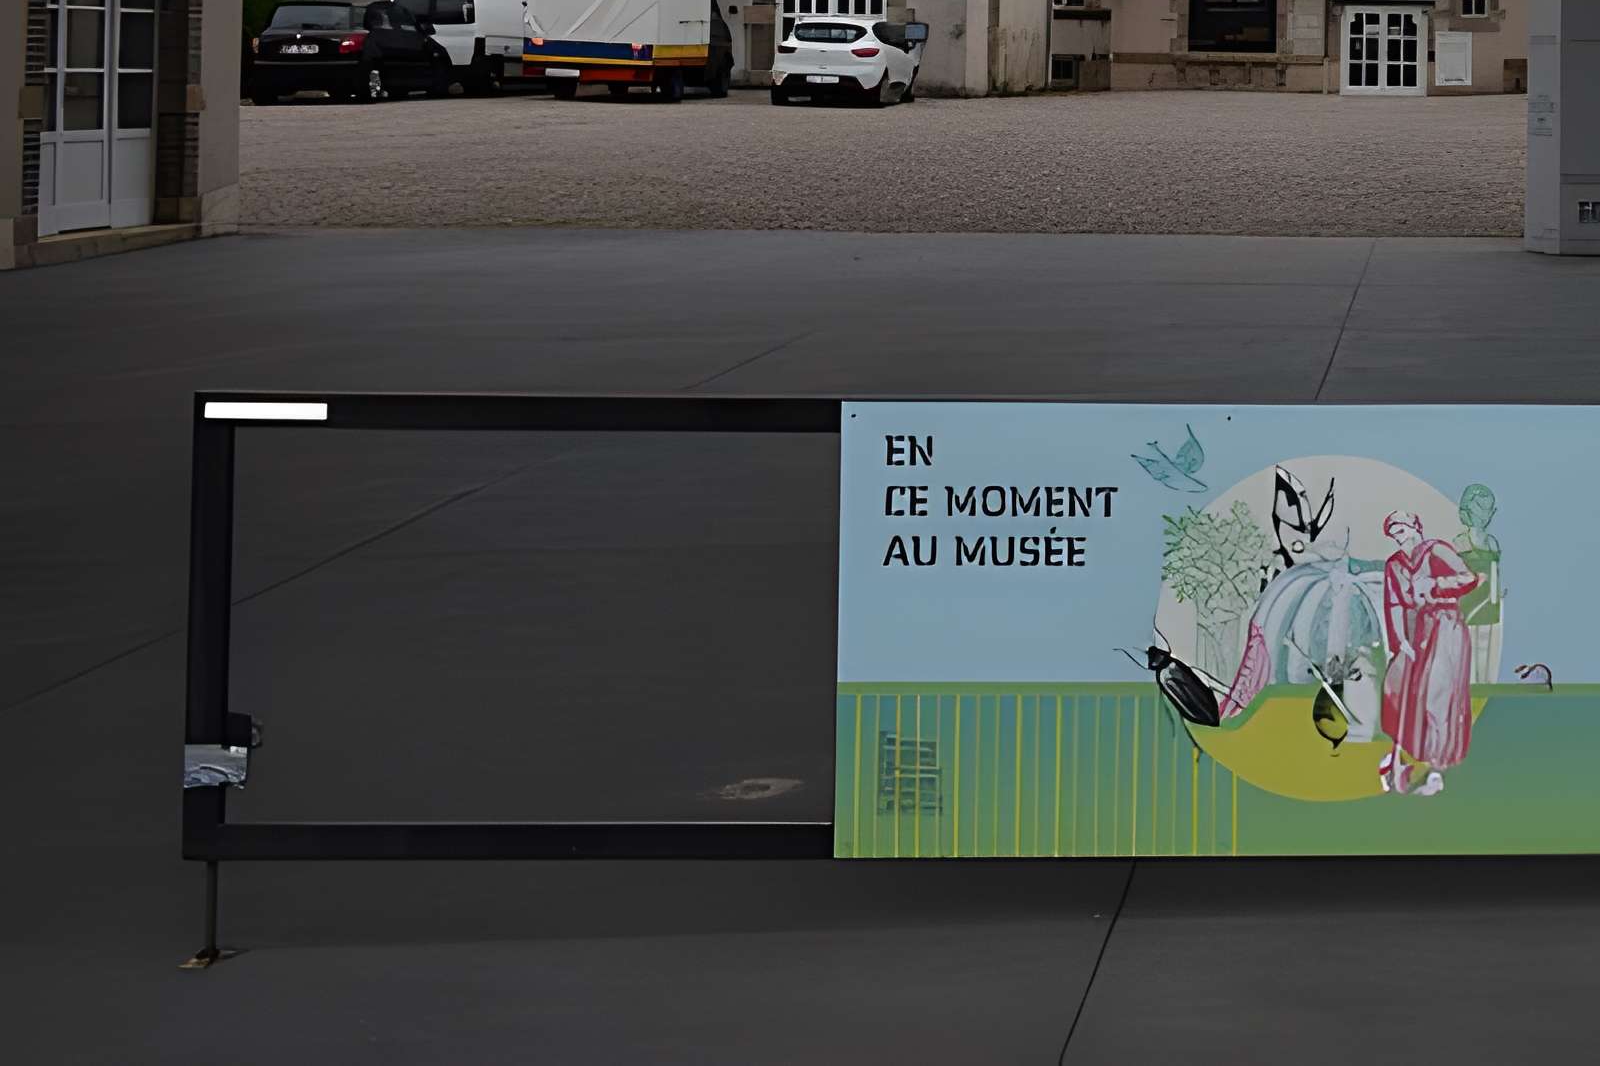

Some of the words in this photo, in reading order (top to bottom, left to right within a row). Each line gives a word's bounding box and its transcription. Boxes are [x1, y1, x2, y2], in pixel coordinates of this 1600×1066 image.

[886, 435, 932, 465] EN
[886, 486, 928, 516] CE
[945, 486, 1118, 517] MOMENT
[883, 536, 936, 565] AU
[956, 527, 1086, 566] MUSÉE
